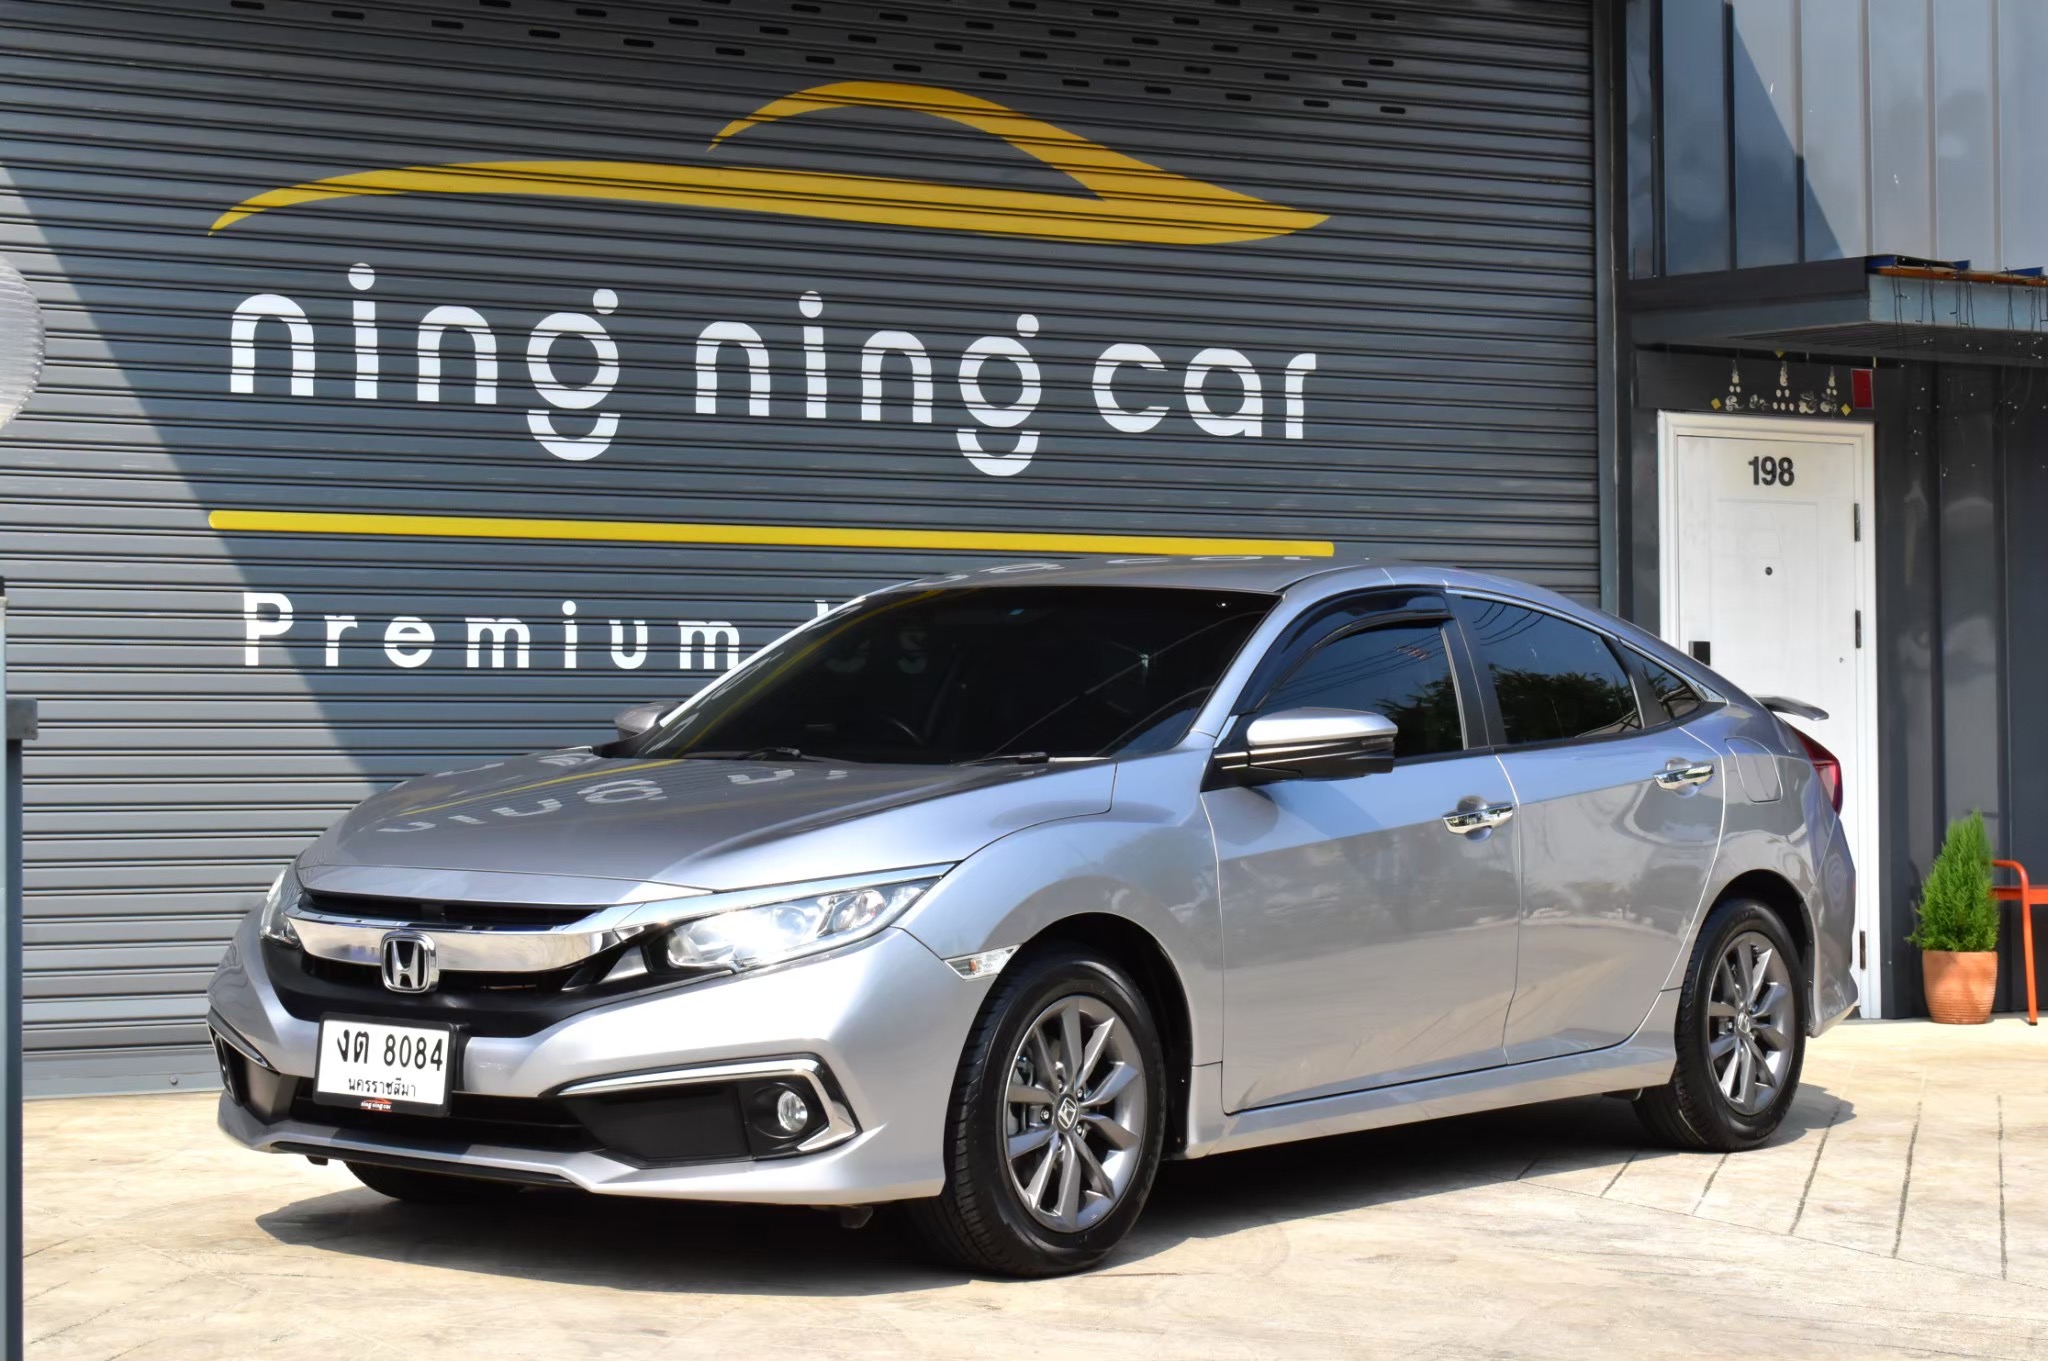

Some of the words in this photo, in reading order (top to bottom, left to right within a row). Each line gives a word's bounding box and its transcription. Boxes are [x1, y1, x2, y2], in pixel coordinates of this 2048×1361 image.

[230, 263, 620, 461] ning
[695, 290, 1041, 476] ning
[1092, 343, 1316, 439] car
[1748, 456, 1794, 487] 198
[243, 592, 740, 669] Premium
[337, 1029, 369, 1064] งต
[384, 1034, 443, 1071] 8084
[348, 1077, 416, 1097] นครราชสีมา
